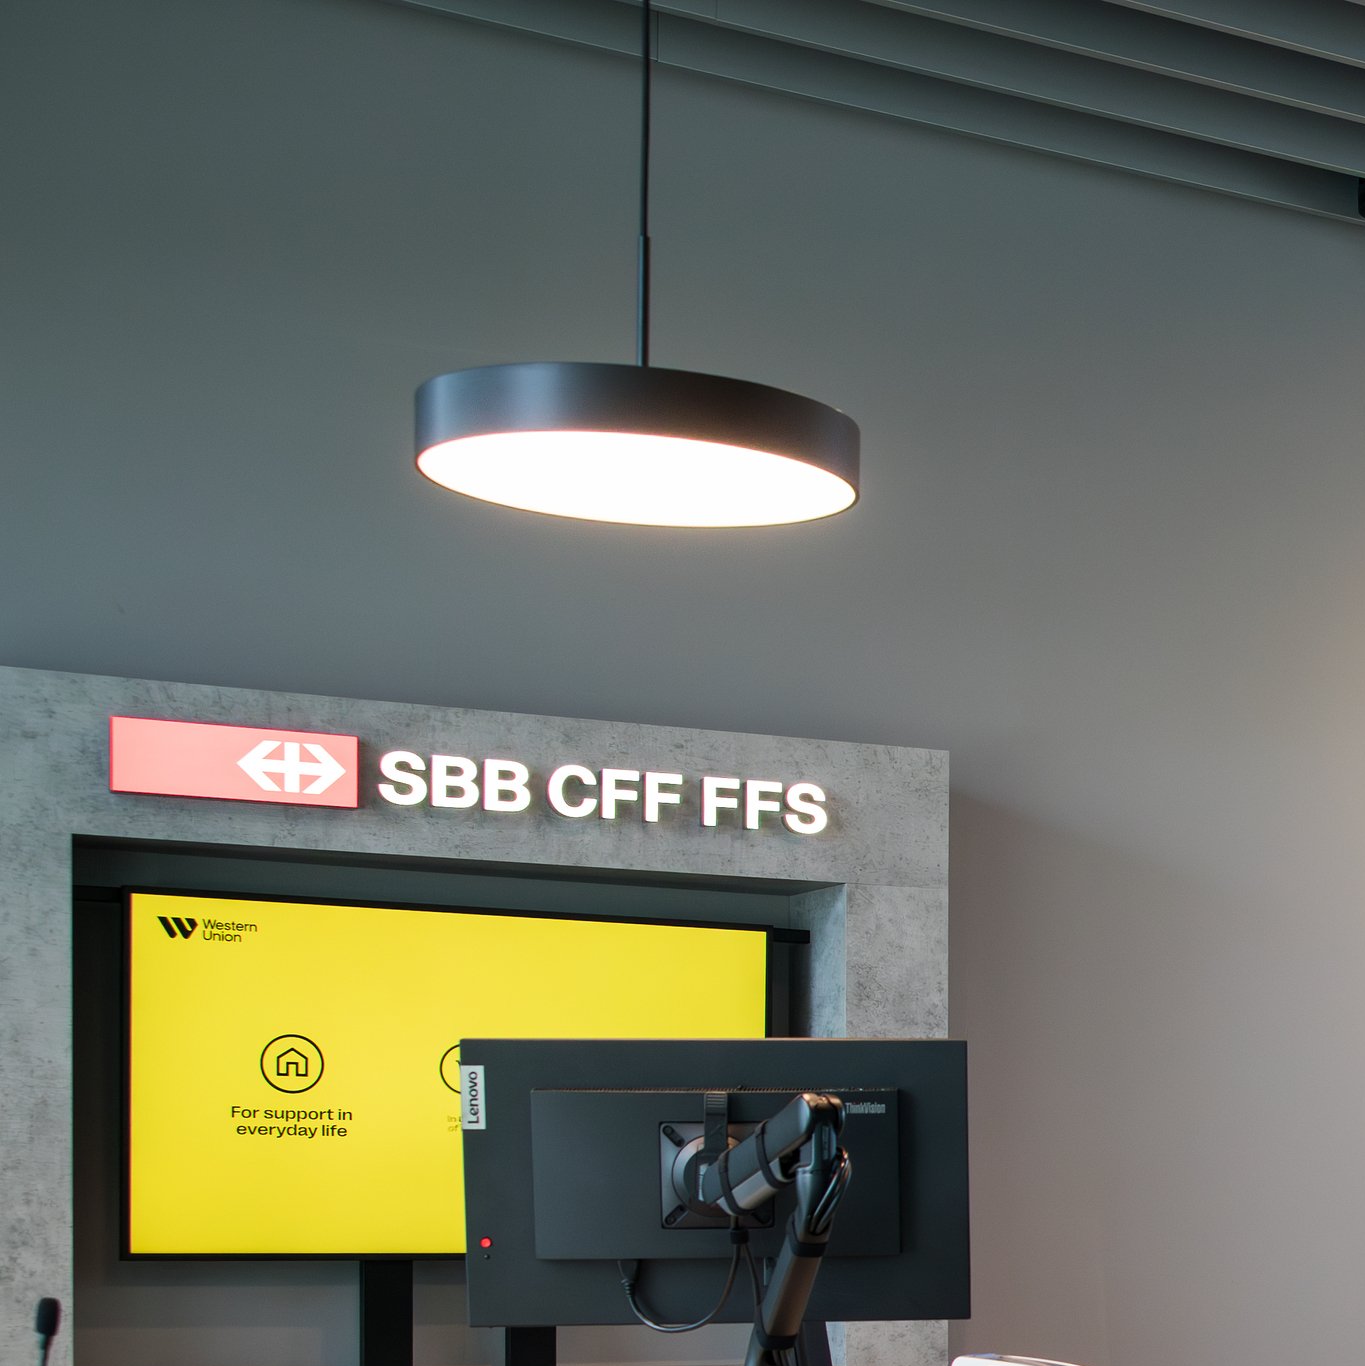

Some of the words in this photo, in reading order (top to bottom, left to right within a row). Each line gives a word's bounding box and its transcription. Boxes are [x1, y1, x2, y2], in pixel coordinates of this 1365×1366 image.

[378, 751, 530, 812] SBB
[547, 764, 683, 822] CFF
[702, 777, 828, 834] FFS
[202, 918, 258, 932] Western
[202, 931, 242, 942] Union
[467, 1071, 480, 1124] Lenovo
[231, 1106, 259, 1119] For
[263, 1108, 334, 1122] support
[338, 1108, 353, 1121] in
[845, 1102, 886, 1114] ThinkVision
[236, 1125, 318, 1138] everyday
[321, 1124, 347, 1137] life
